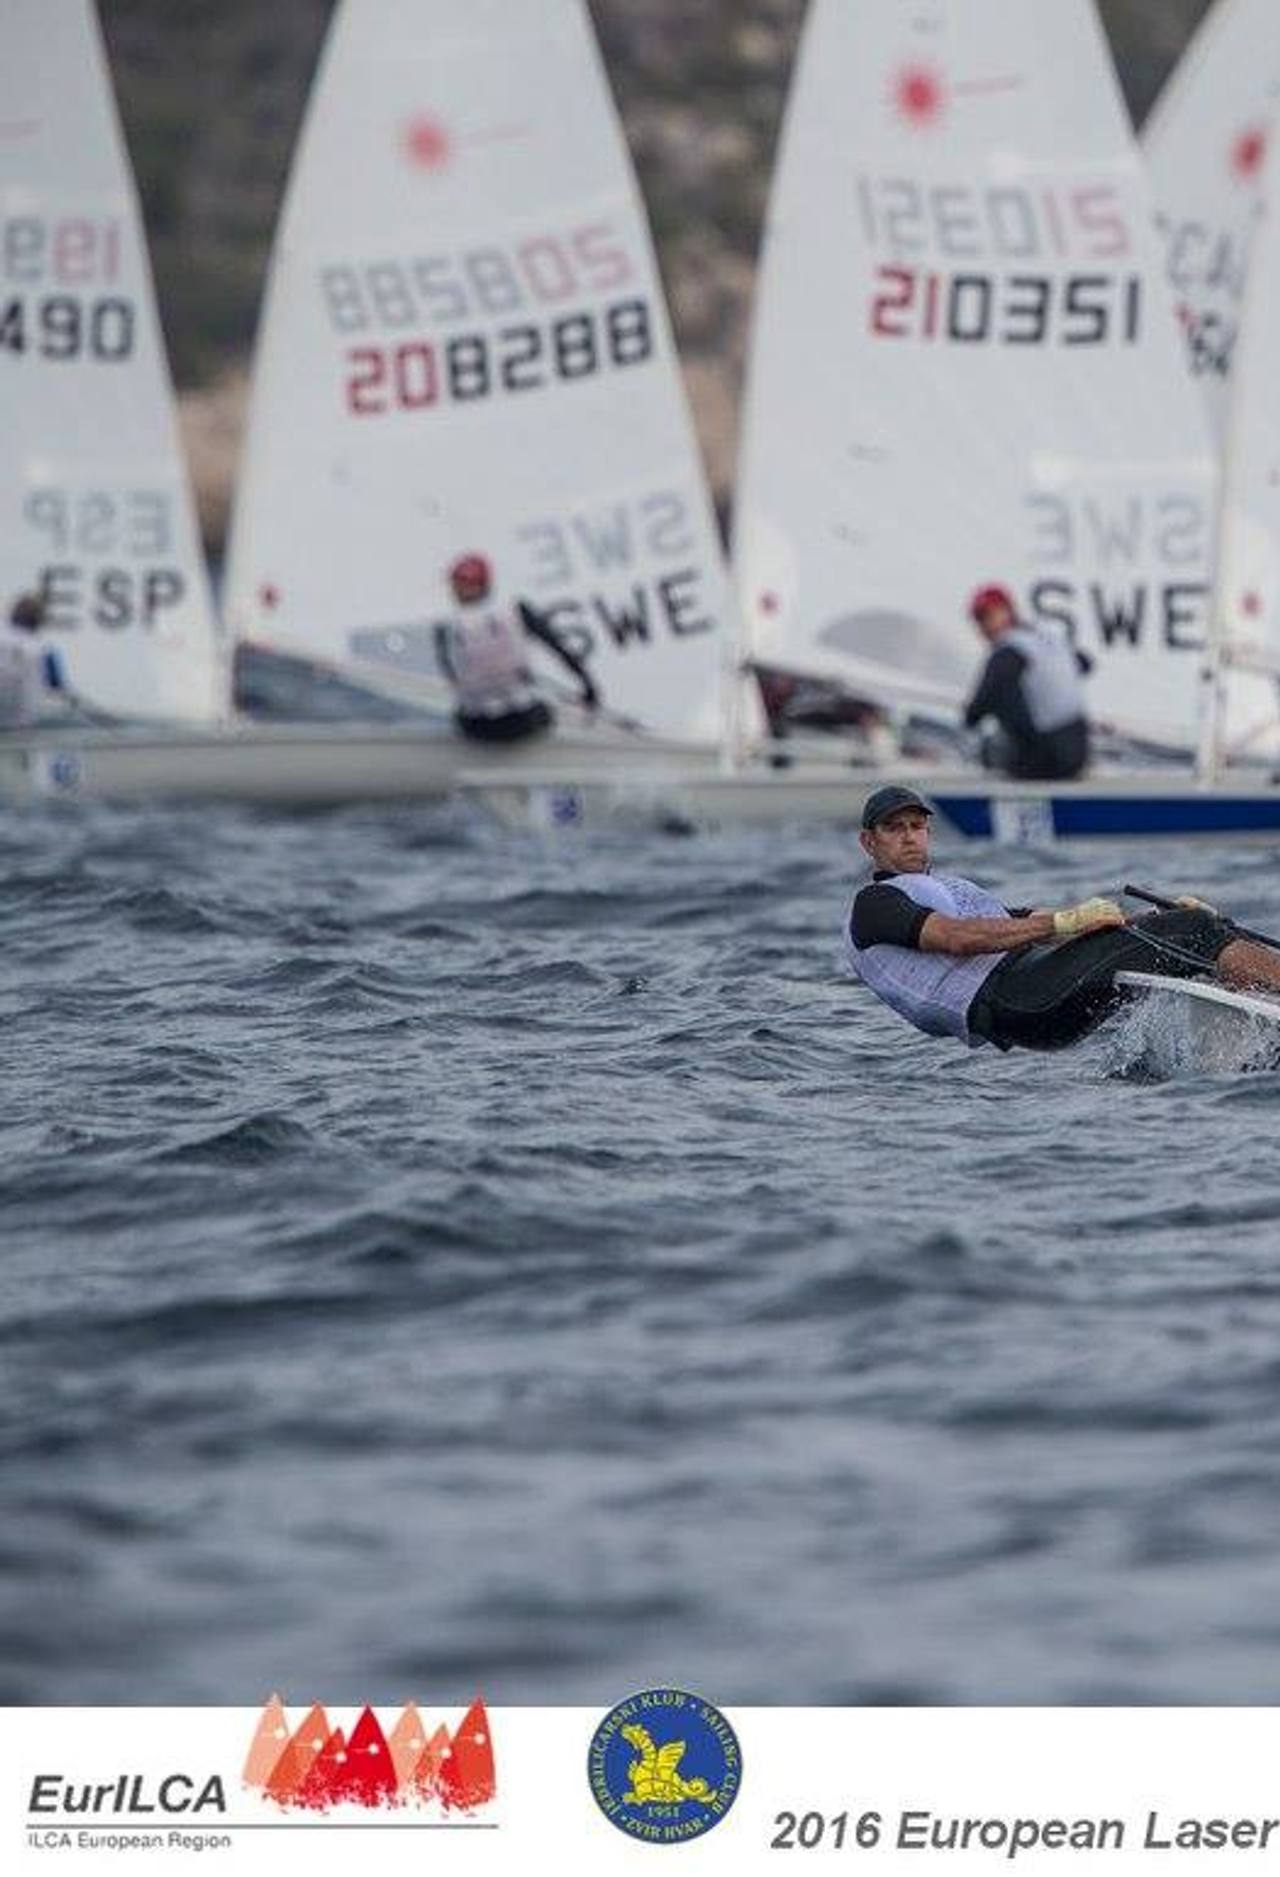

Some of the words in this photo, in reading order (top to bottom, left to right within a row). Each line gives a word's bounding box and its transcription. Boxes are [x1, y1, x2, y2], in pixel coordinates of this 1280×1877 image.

[872, 264, 1140, 345] 210351
[346, 299, 652, 414] 208288
[38, 563, 186, 633] ESP
